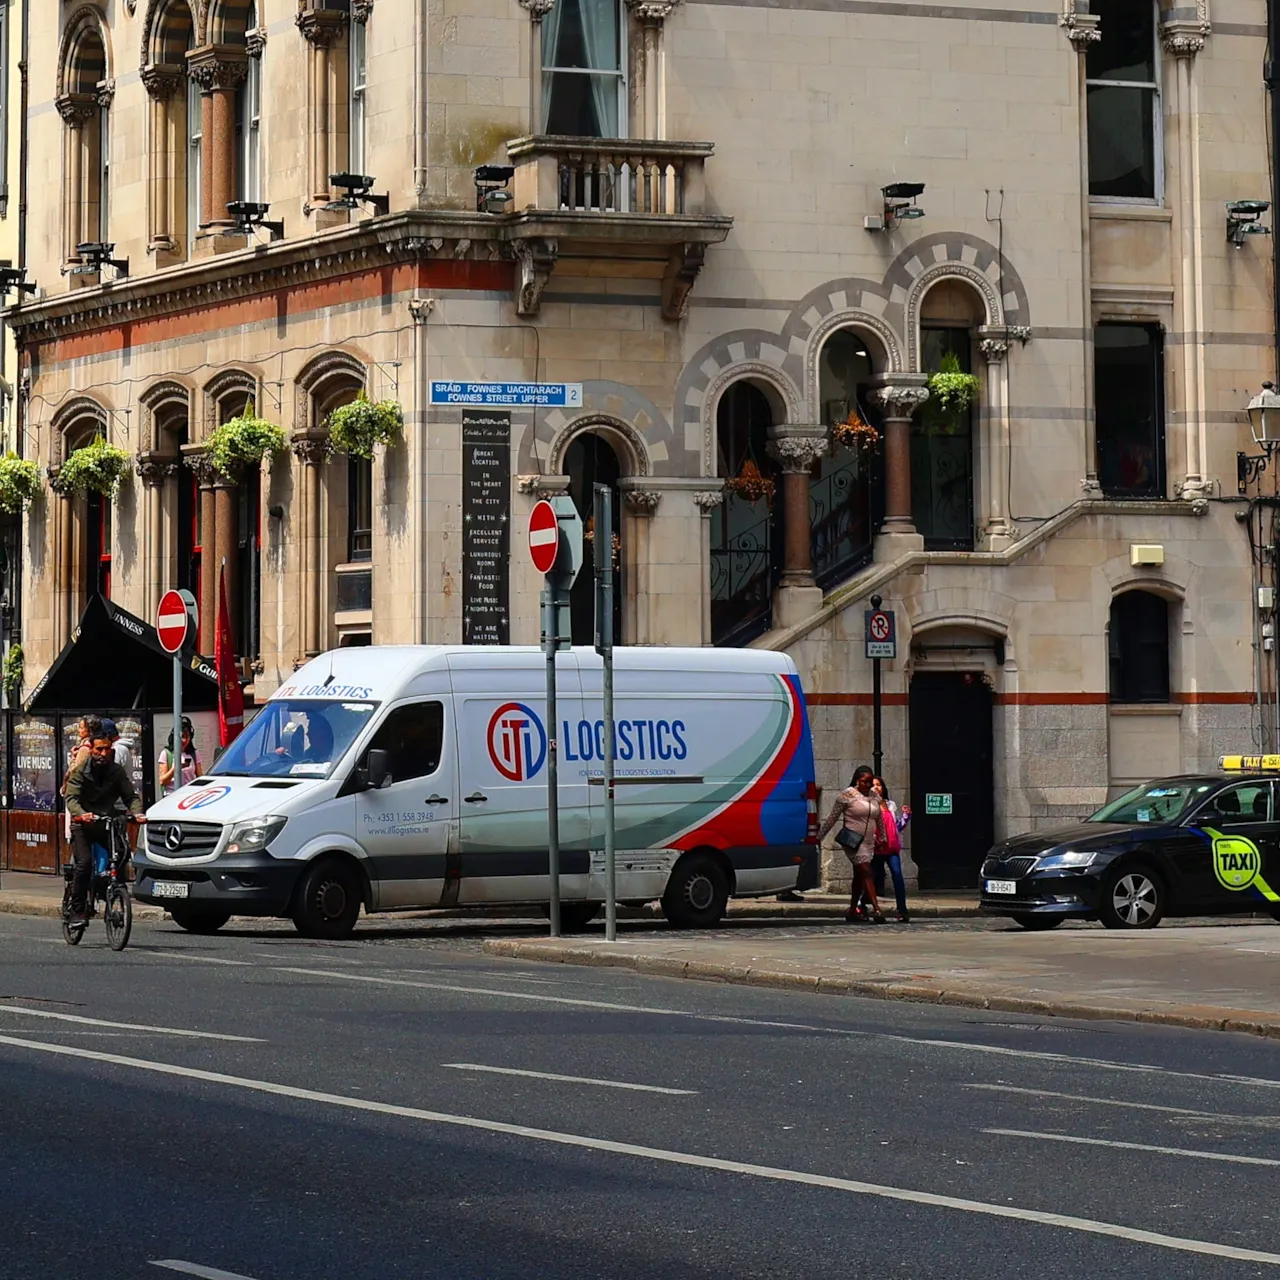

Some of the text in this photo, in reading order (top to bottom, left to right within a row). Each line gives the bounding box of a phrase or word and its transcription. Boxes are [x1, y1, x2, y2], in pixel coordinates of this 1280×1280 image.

[435, 383, 562, 395] SRÁID FOWNES UACHTARACH
[571, 390, 577, 400] 2
[448, 394, 548, 403] FOWNES STREET UPPER
[299, 685, 373, 699] LOGISTICS
[563, 720, 687, 761] LOGISTICS
[17, 756, 52, 769] LIVE MUSIC
[1244, 757, 1260, 767] TAXI
[378, 813, 394, 822] +353
[403, 812, 415, 821] 558
[1220, 853, 1254, 871] TAXI
